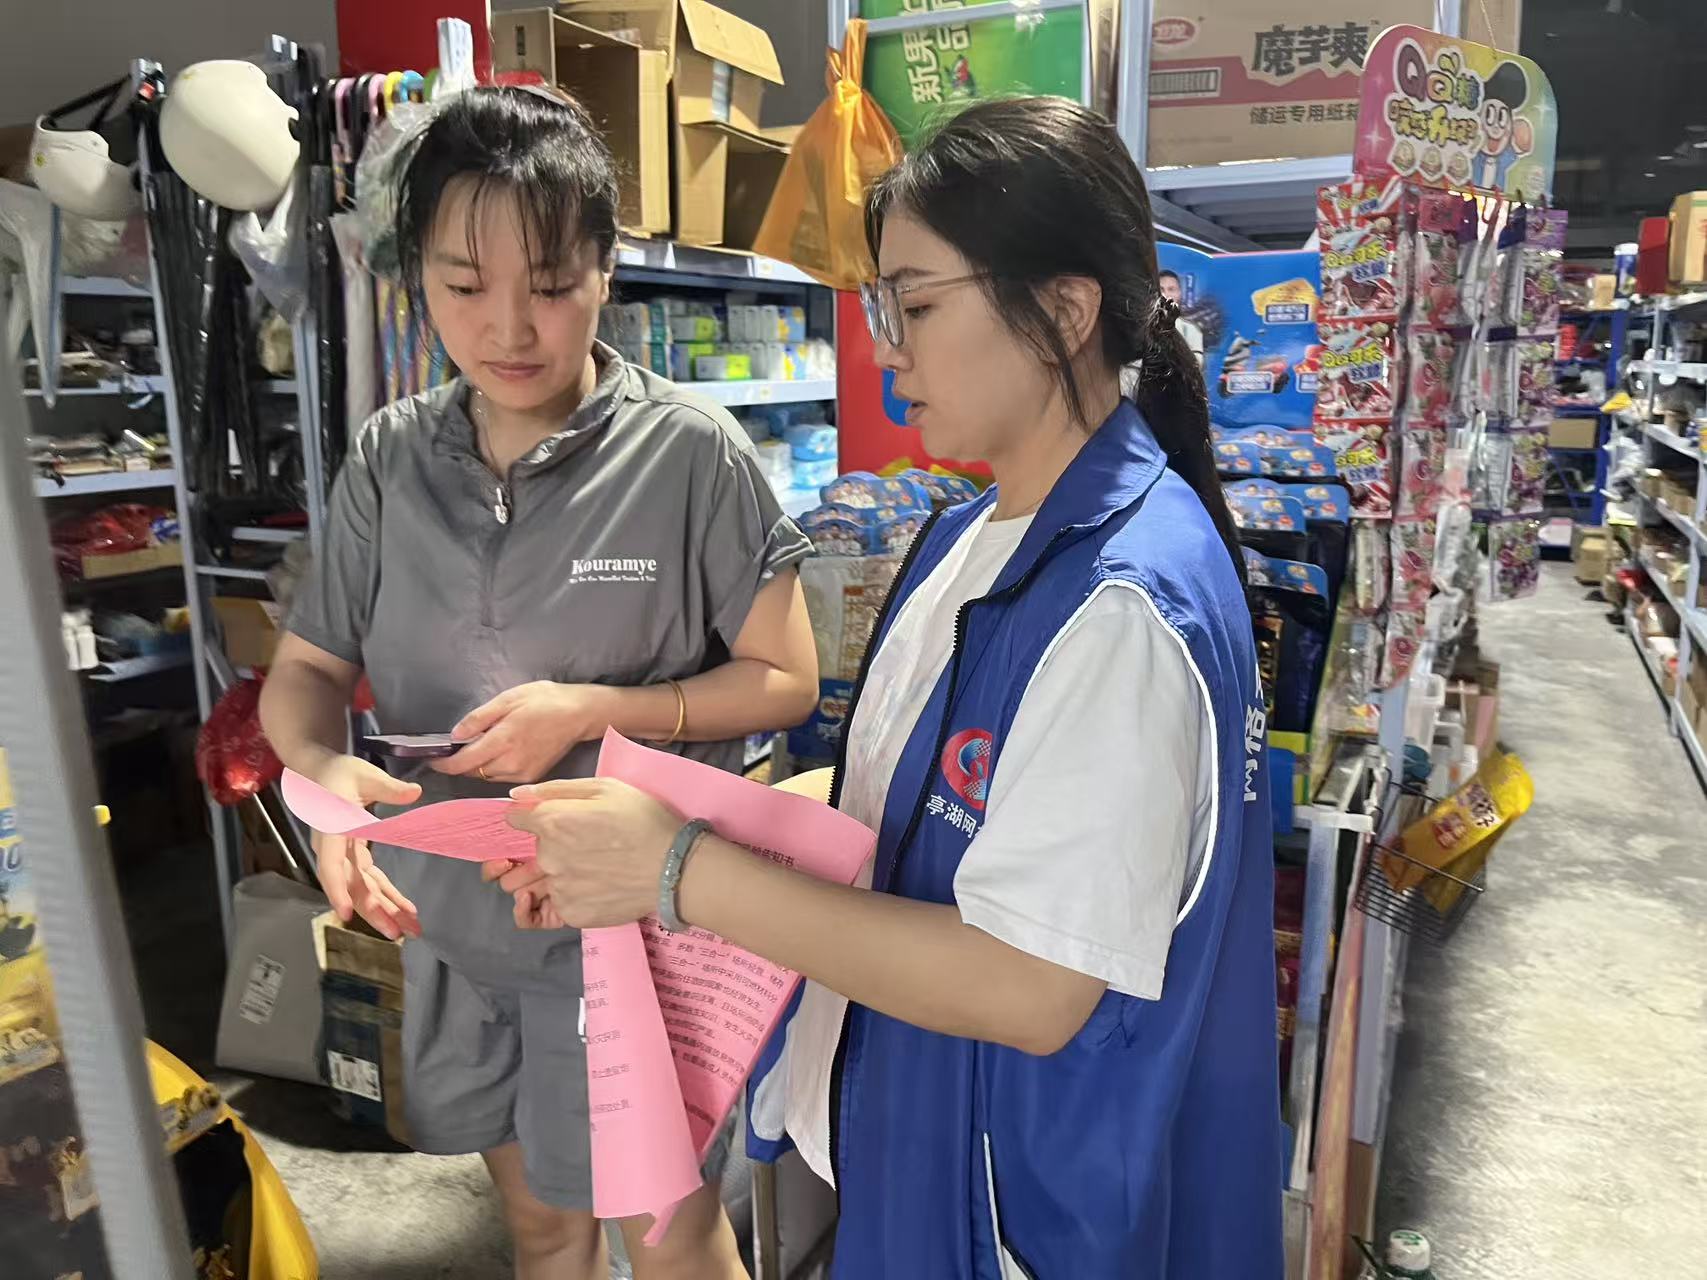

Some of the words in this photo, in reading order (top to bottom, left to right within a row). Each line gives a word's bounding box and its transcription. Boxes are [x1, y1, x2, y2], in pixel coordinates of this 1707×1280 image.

[1251, 21, 1369, 77] 魔芋爽
[571, 558, 657, 576] Kouramye
[926, 794, 982, 839] 亭湖网
